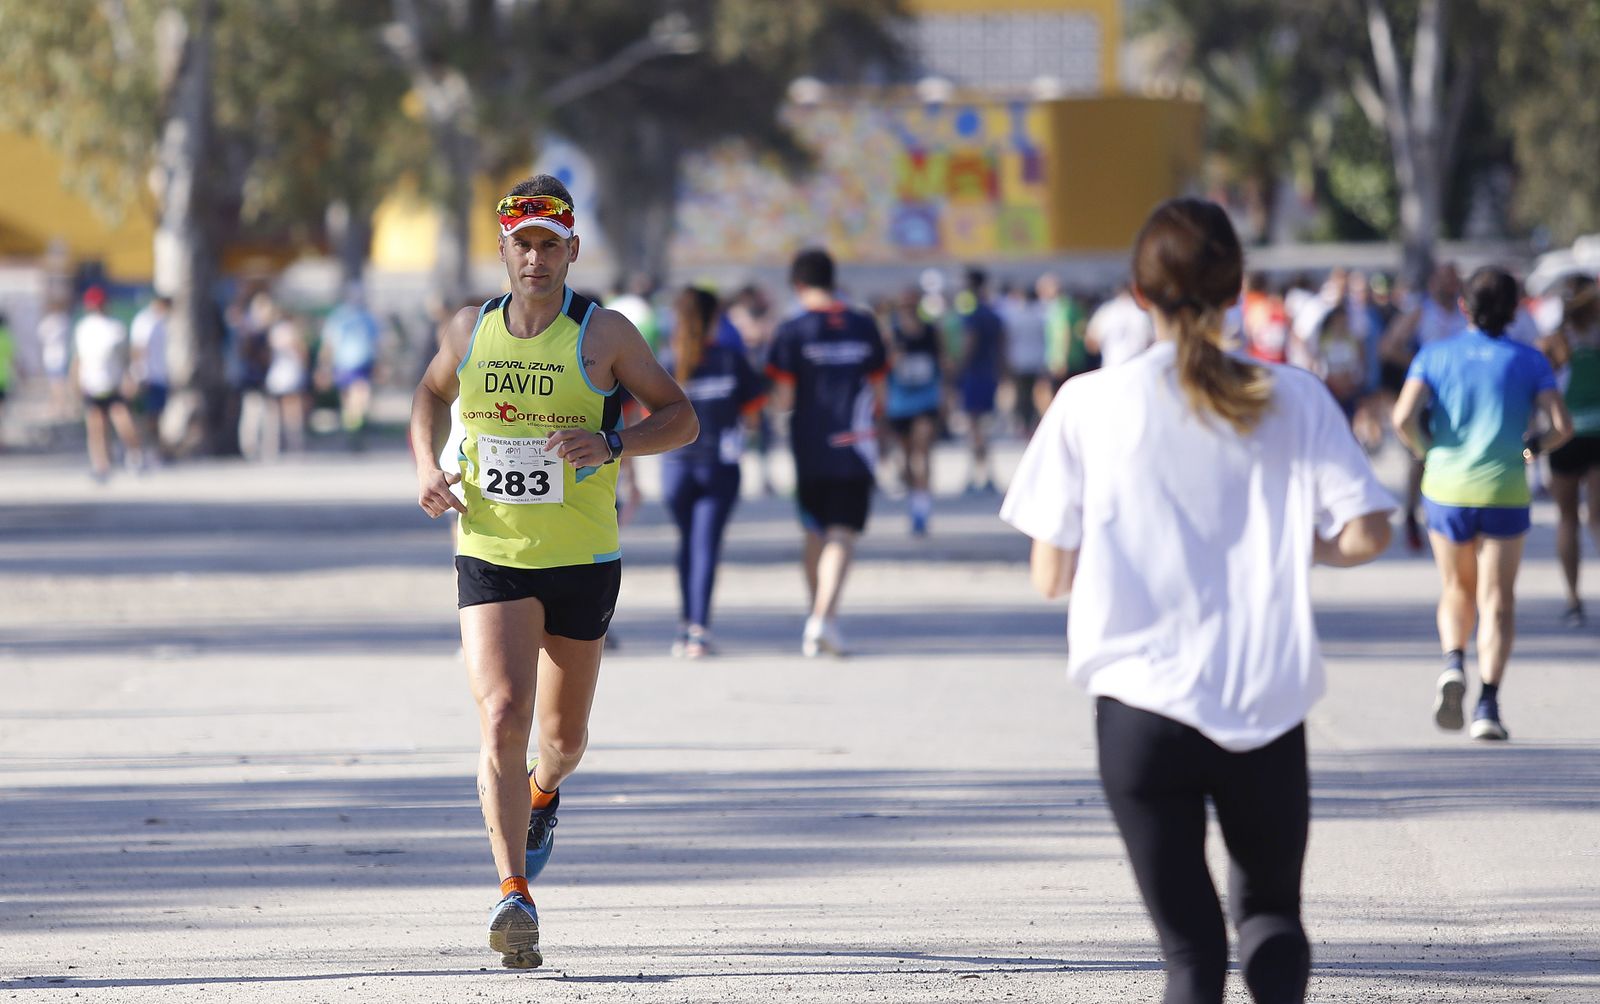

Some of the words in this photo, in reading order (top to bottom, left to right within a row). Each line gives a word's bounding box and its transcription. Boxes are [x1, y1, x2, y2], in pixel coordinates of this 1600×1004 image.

[487, 360, 525, 369] PEARL
[485, 373, 554, 396] DAVID
[487, 437, 511, 446] CARRERA
[486, 468, 551, 497] 283
